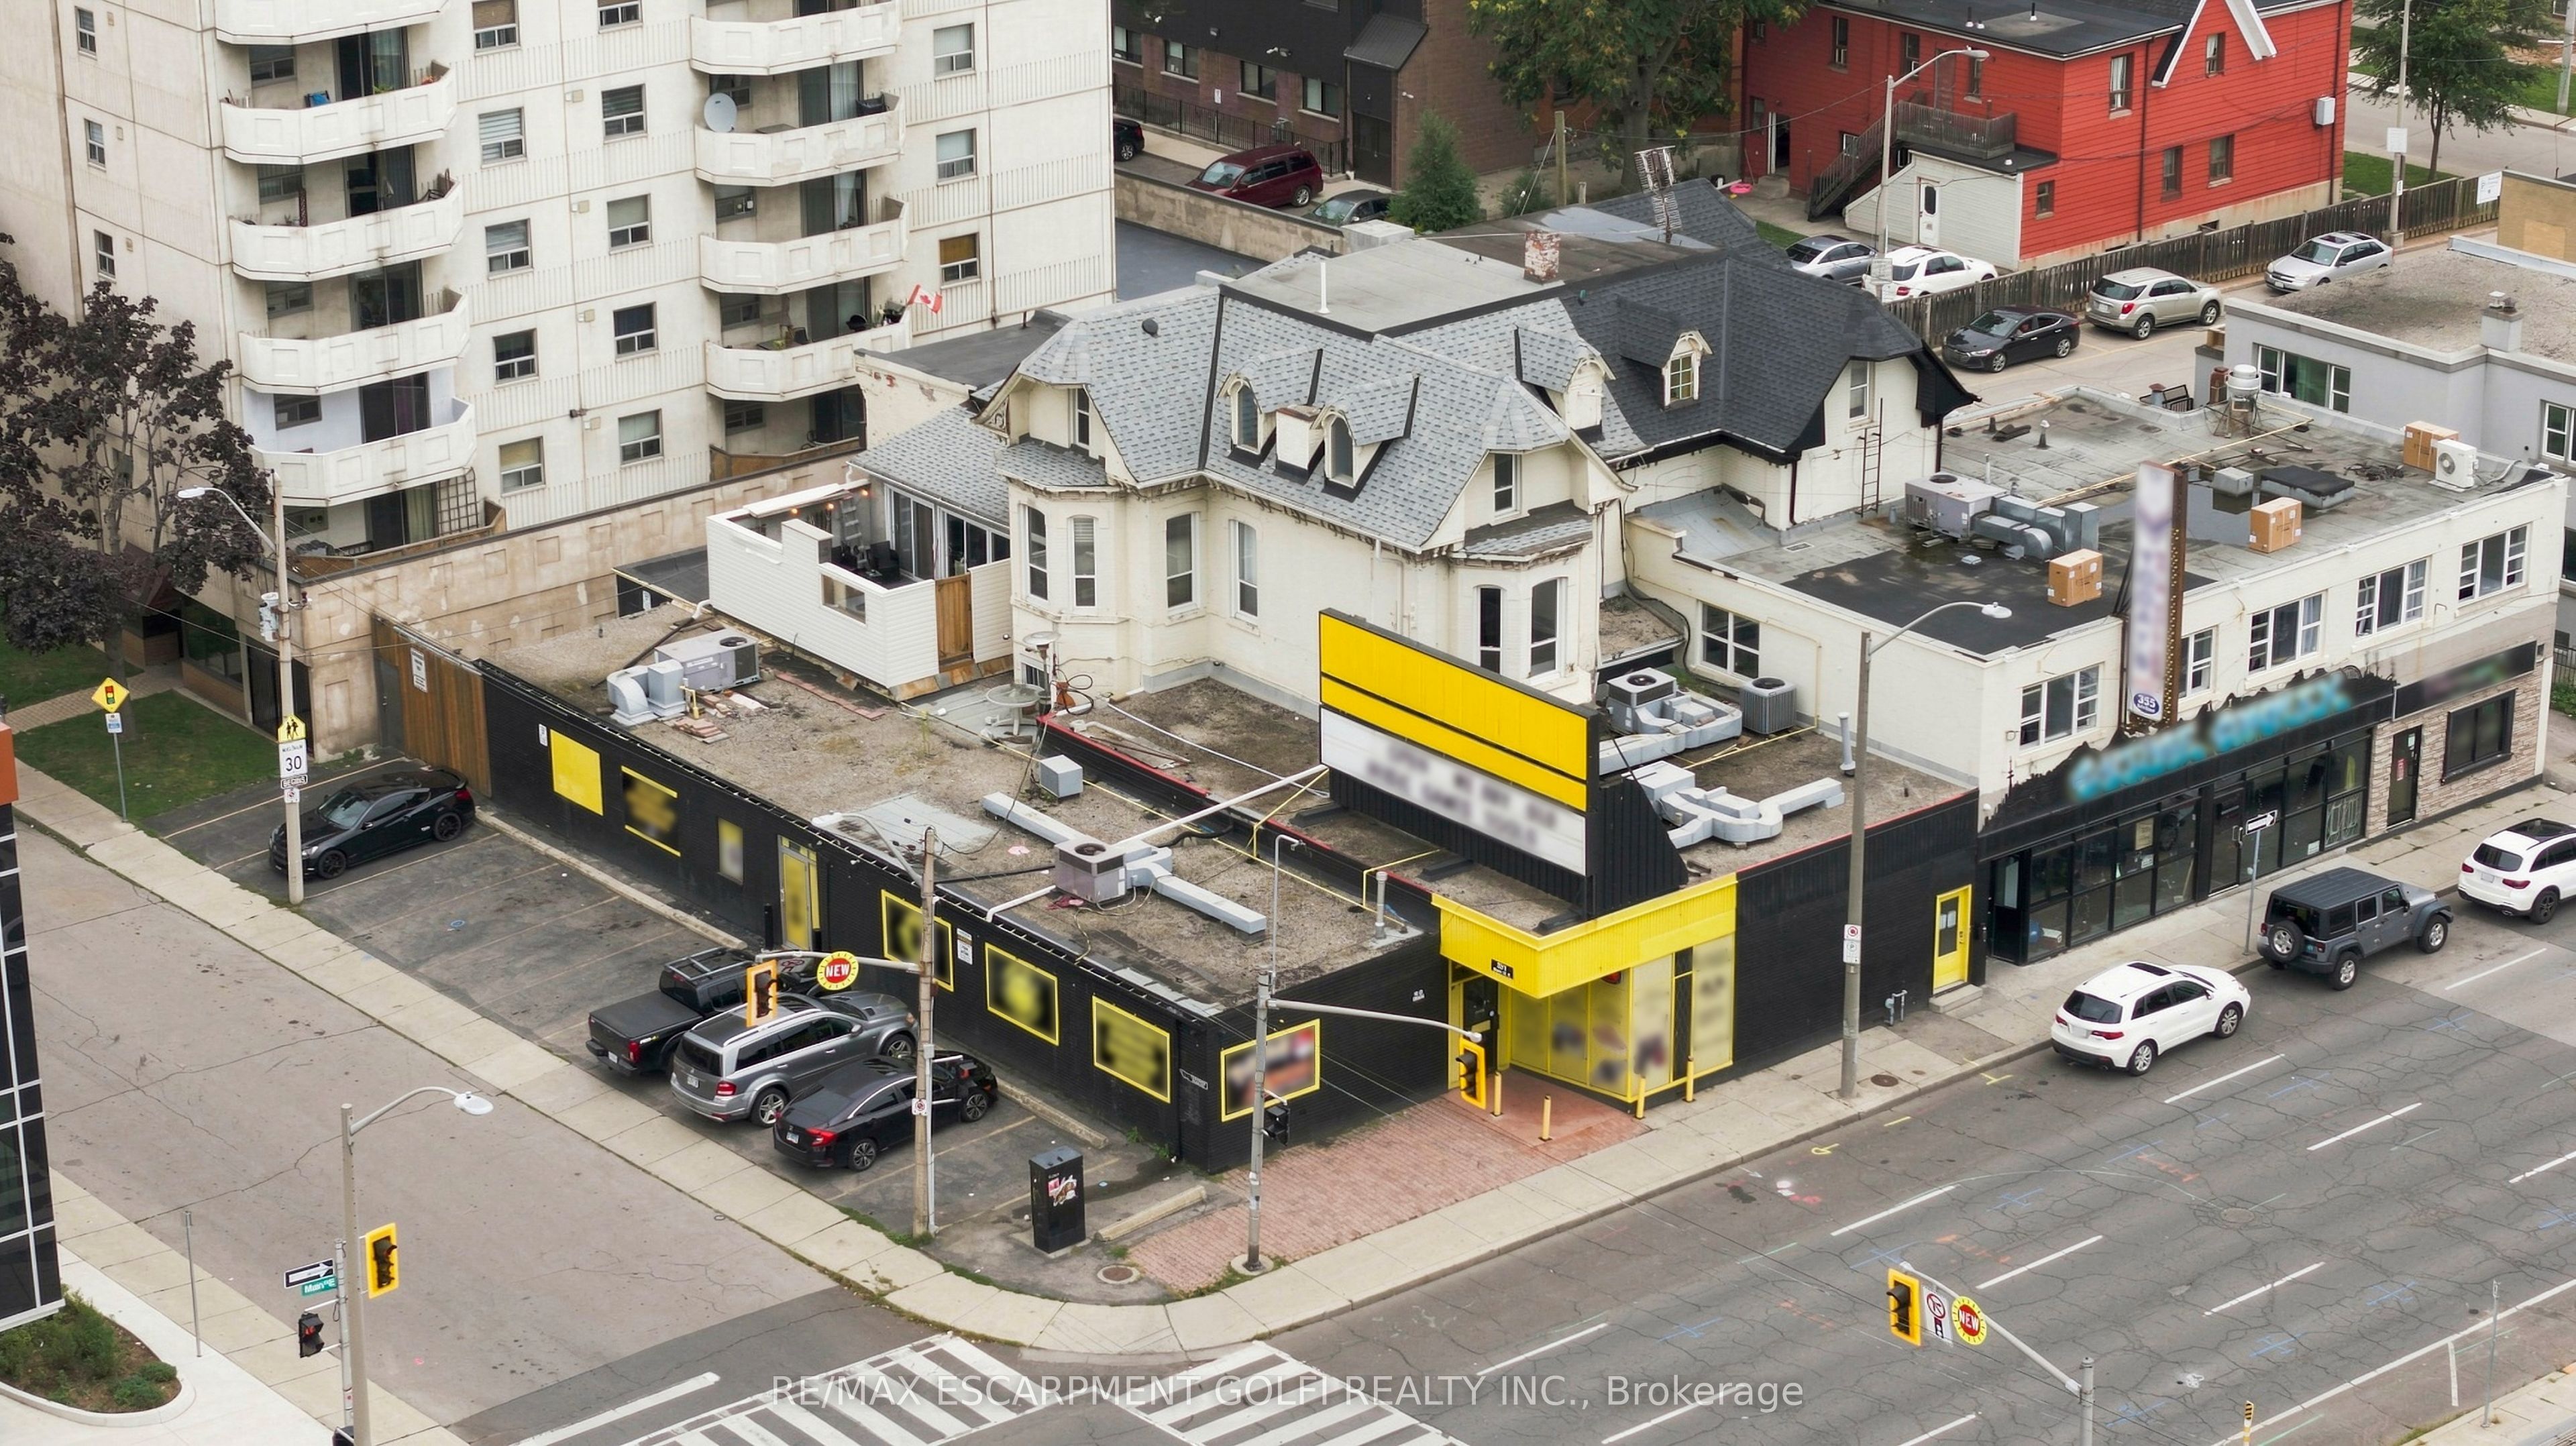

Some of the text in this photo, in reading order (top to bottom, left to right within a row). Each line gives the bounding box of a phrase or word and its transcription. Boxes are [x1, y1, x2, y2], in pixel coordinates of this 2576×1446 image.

[2137, 694, 2156, 708] 355
[286, 755, 302, 771] 30
[826, 963, 850, 978] NEW
[304, 1282, 325, 1294] Main
[1959, 1309, 1979, 1331] NEW
